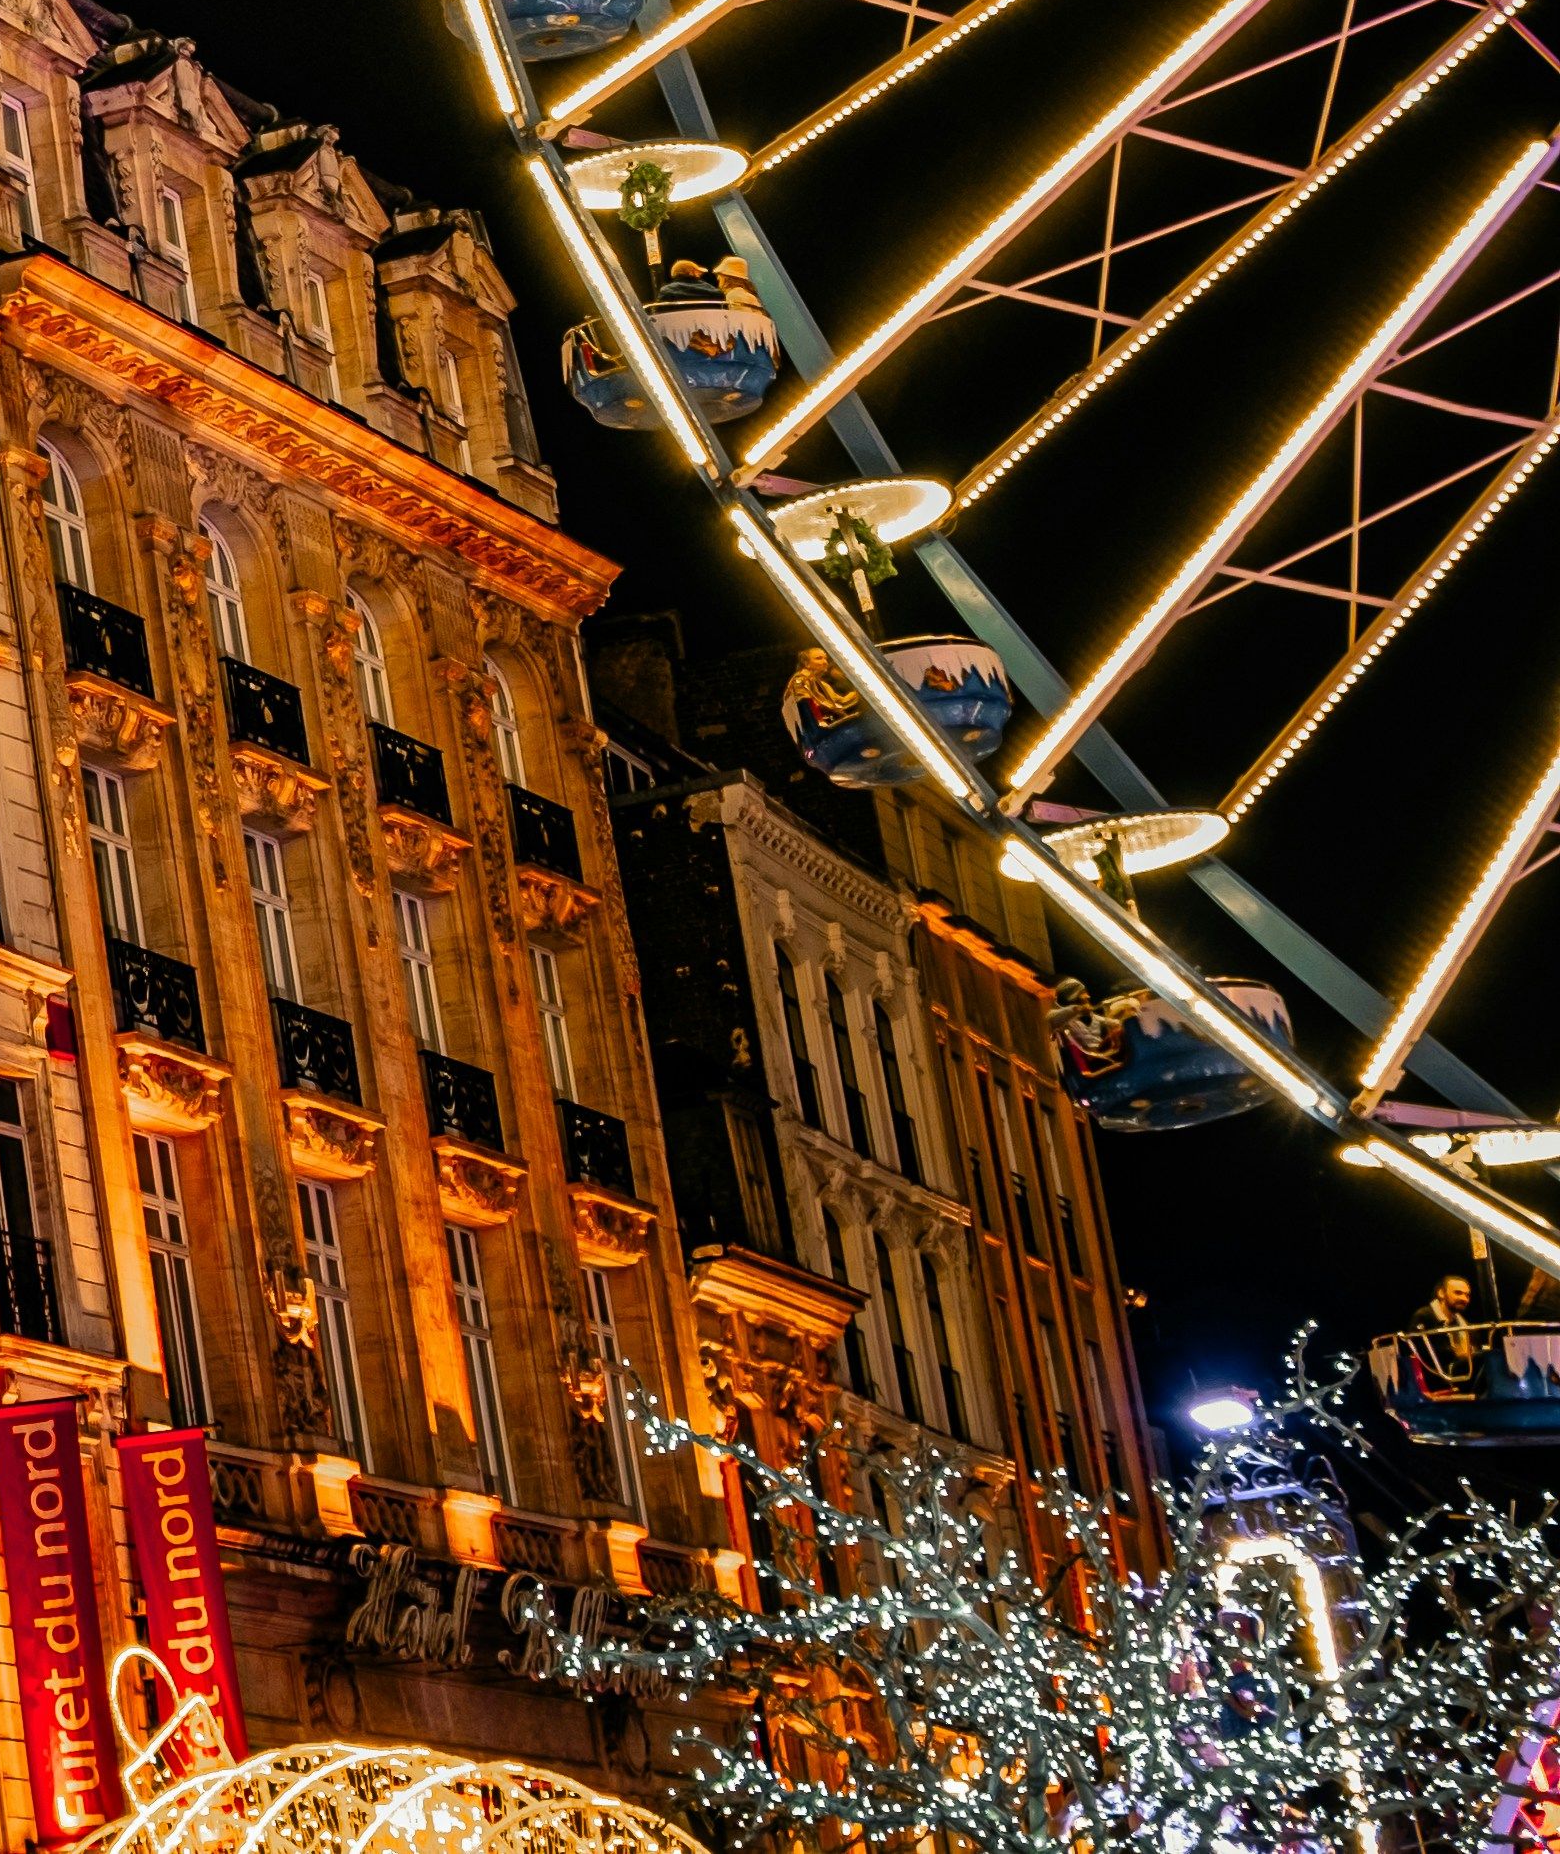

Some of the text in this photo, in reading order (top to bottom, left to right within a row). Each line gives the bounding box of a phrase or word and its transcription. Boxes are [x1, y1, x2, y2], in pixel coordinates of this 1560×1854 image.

[141, 1447, 201, 1582] nord
[12, 1418, 106, 1834] Furet du nord
[168, 1595, 215, 1675] du
